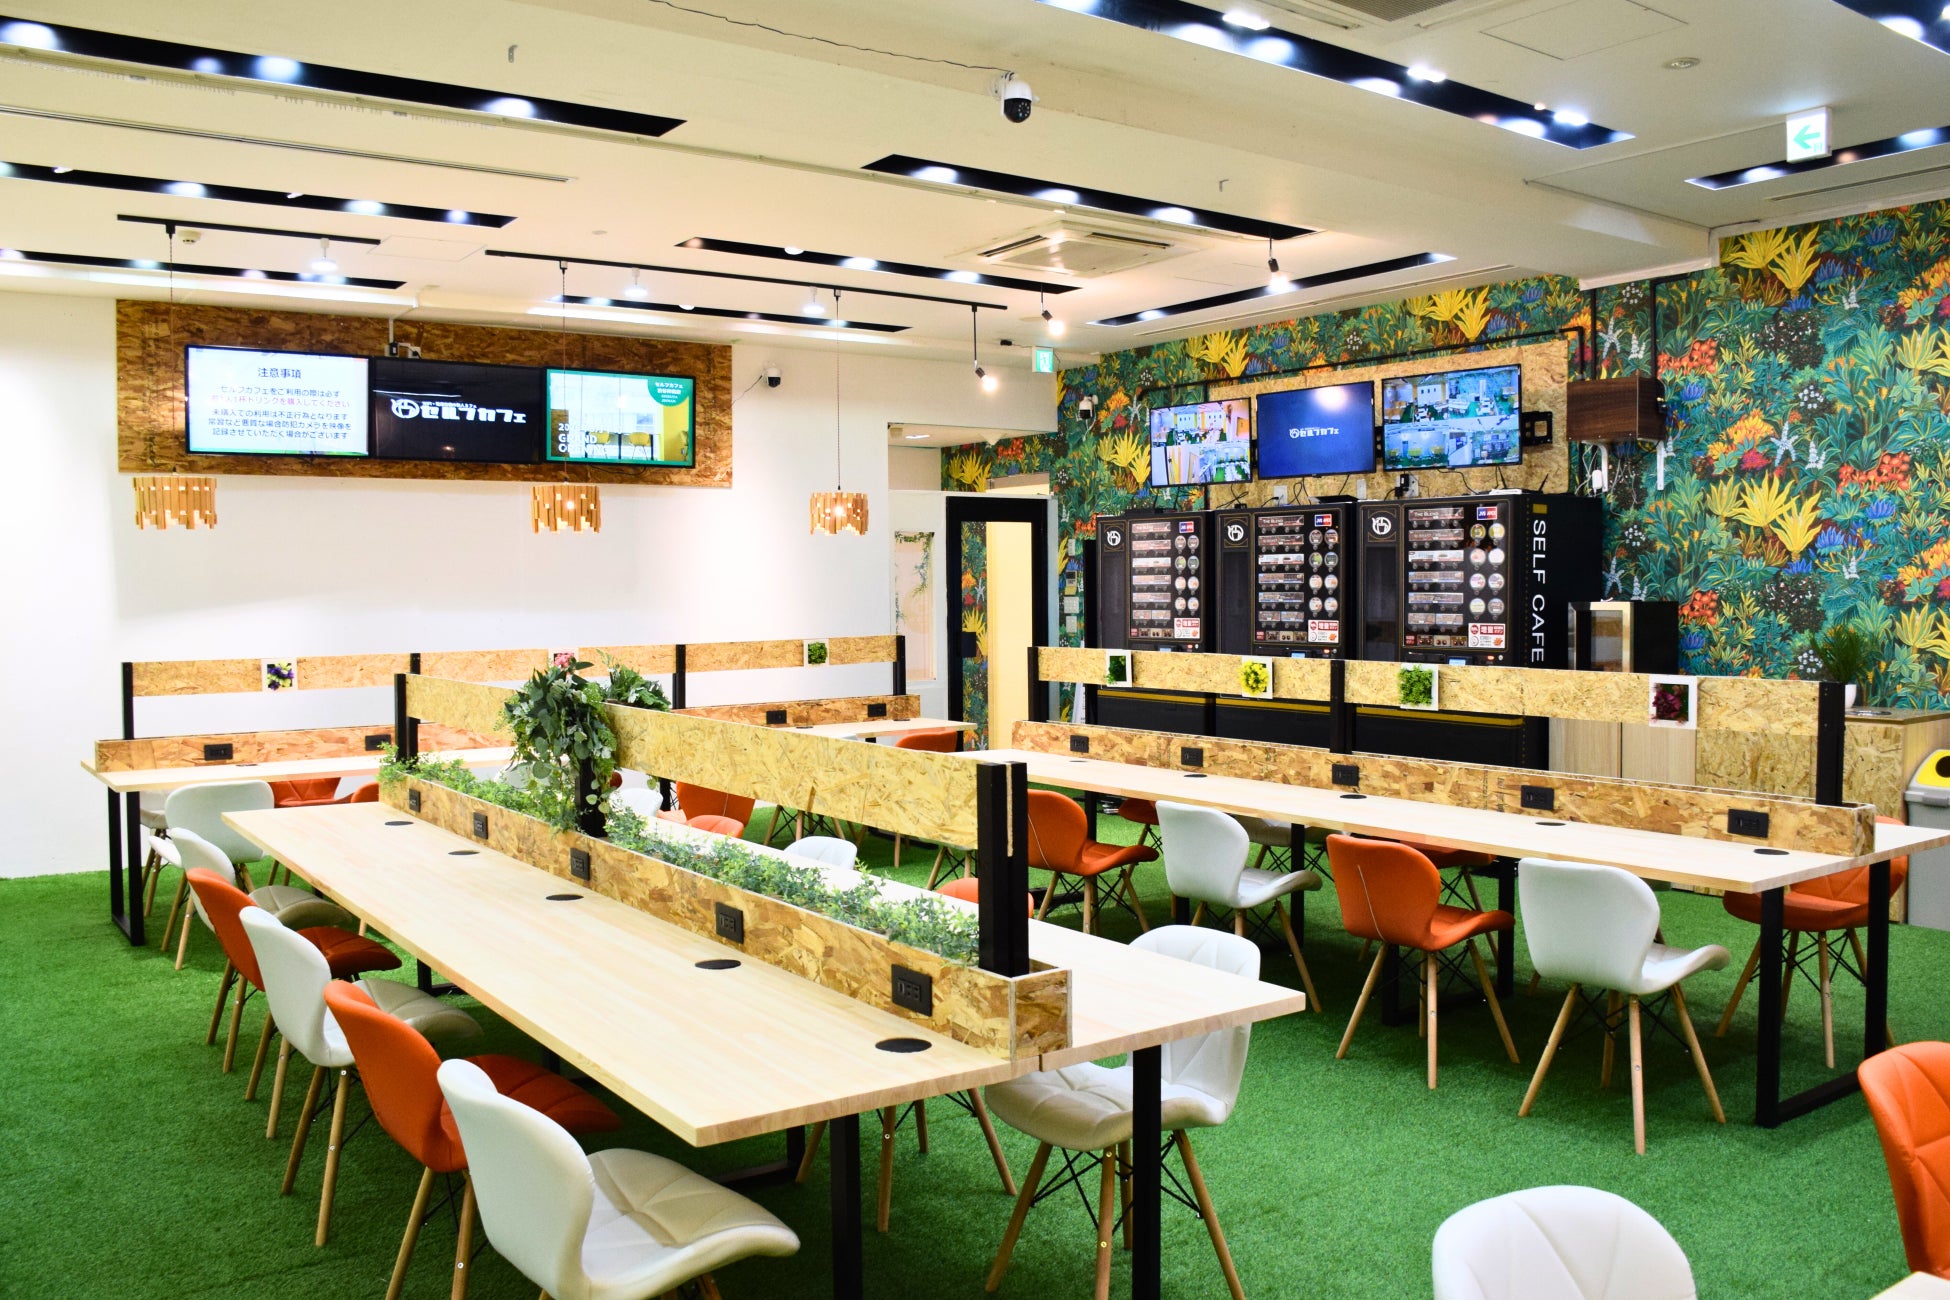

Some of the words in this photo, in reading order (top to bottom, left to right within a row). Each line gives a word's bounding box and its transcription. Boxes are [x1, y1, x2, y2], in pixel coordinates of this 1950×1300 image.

[257, 367, 302, 379] 注意事項
[420, 405, 527, 423] セルフカフェ
[1532, 519, 1547, 585] SELF
[1531, 594, 1546, 663] CAFE
